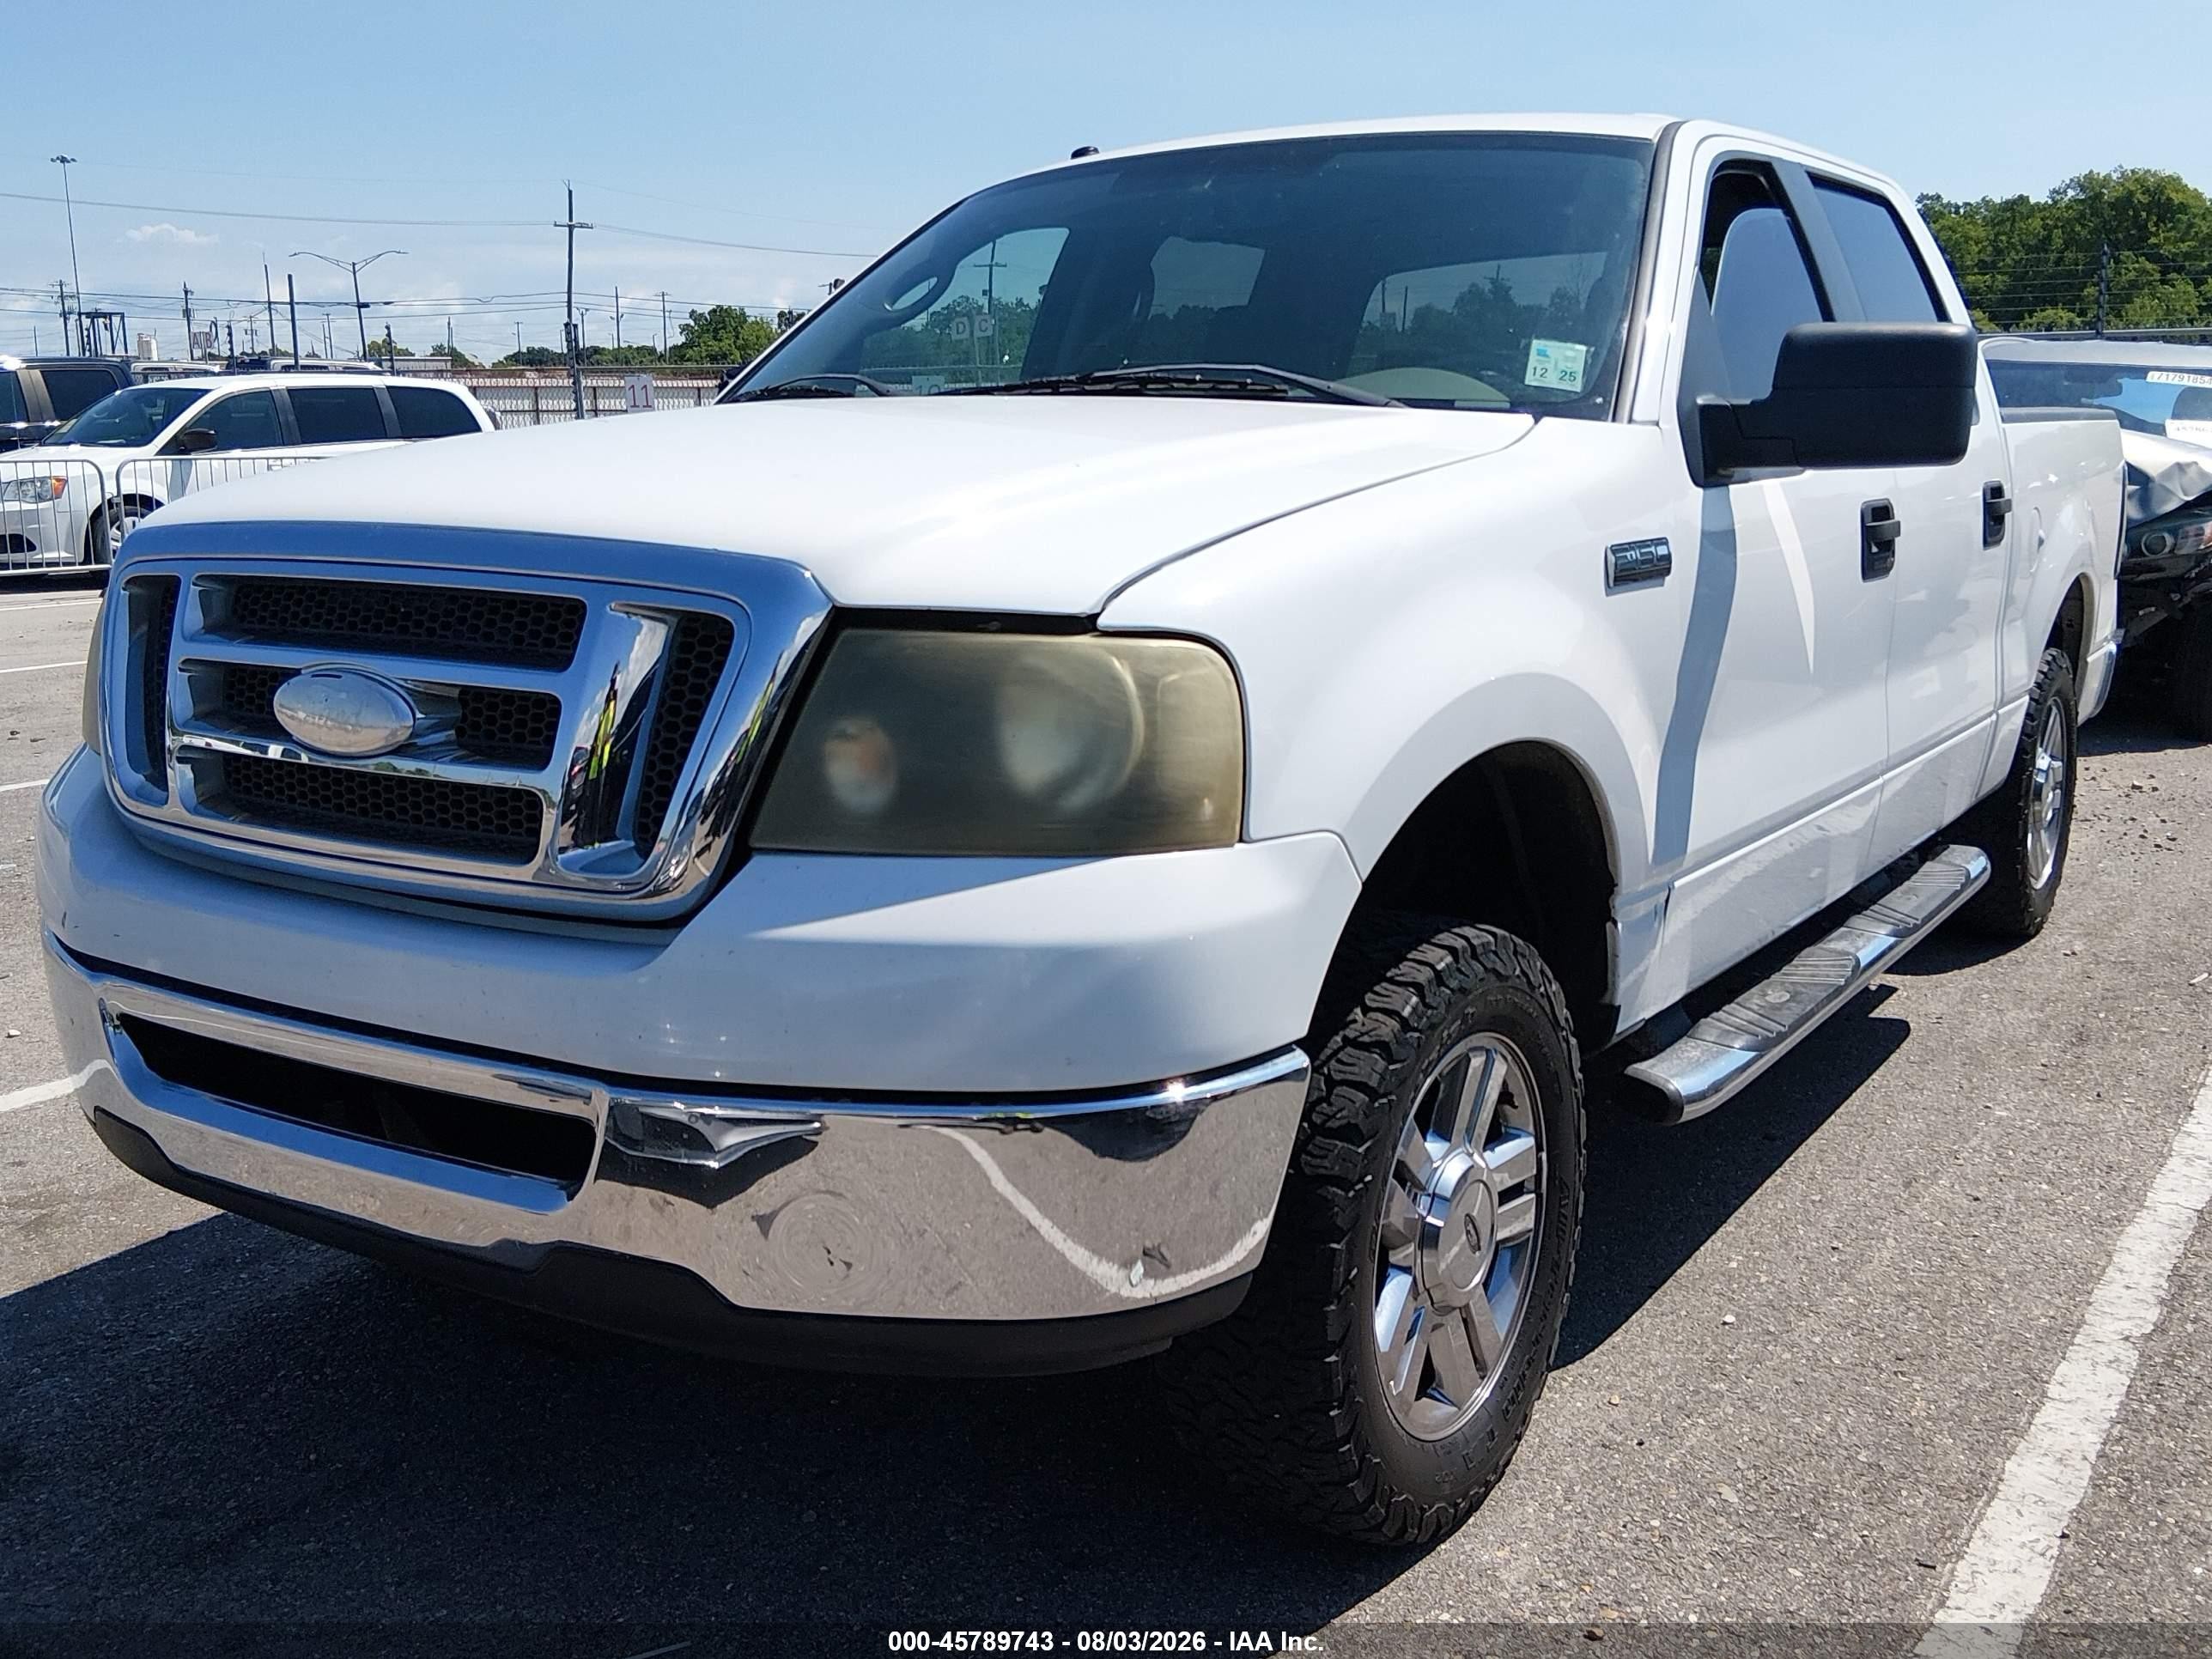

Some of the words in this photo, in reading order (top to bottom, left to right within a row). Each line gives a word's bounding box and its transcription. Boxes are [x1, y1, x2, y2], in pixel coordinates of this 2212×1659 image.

[956, 321, 967, 335] D
[979, 319, 988, 333] C
[192, 332, 201, 349] A
[205, 331, 213, 349] B
[1532, 366, 1548, 379] 12
[1559, 370, 1577, 382] 25
[628, 384, 653, 408] 11
